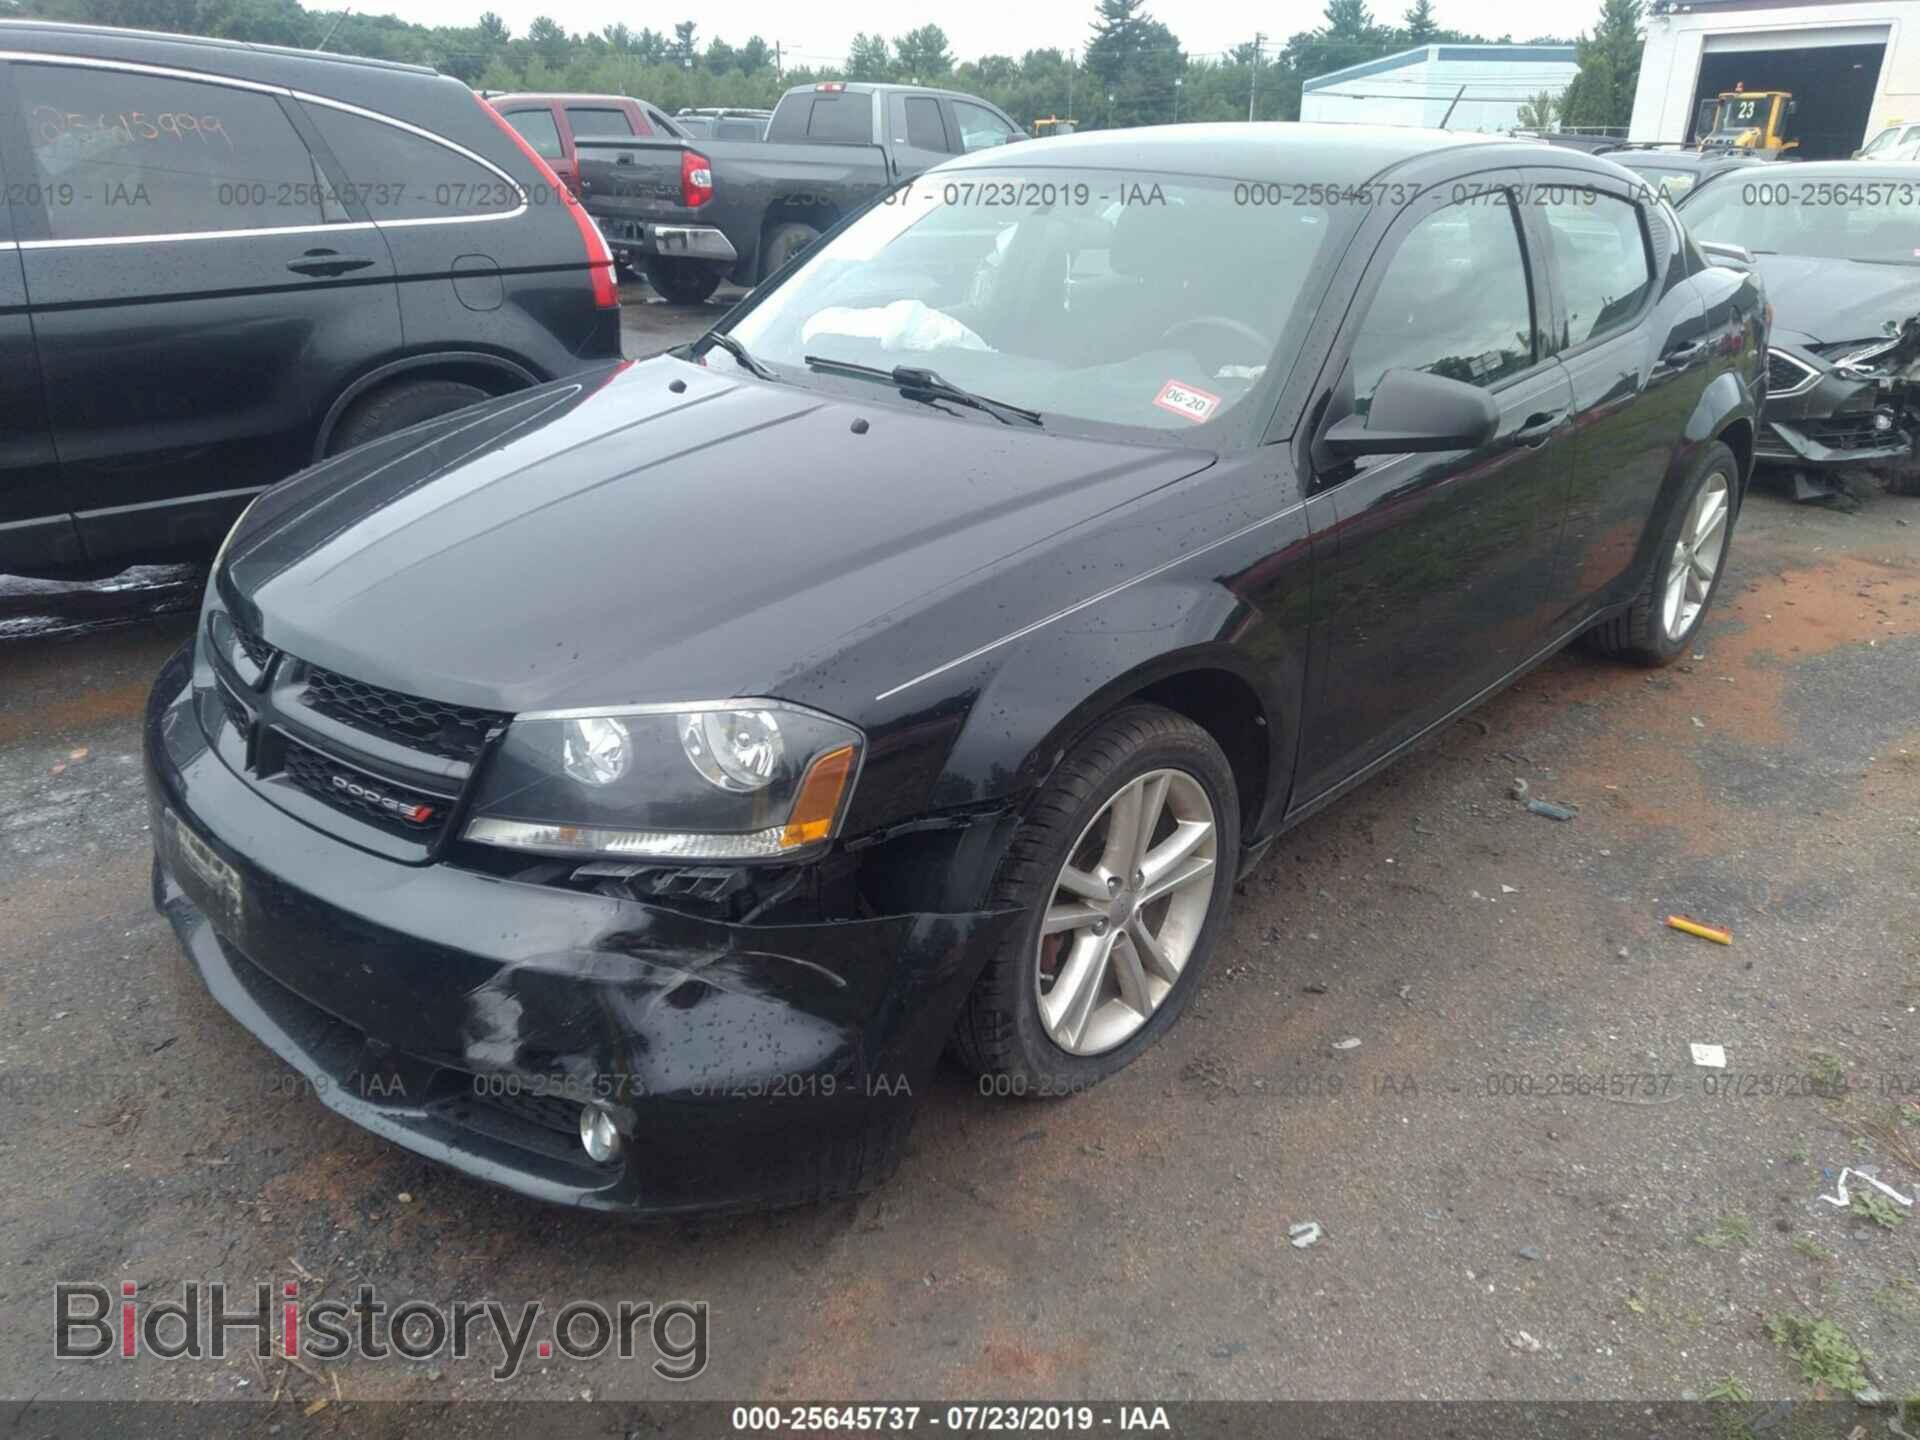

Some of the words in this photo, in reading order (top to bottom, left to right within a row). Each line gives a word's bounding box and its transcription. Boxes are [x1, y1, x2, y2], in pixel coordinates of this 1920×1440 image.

[1737, 101, 1756, 119] 23
[1166, 389, 1206, 411] 06-20
[332, 775, 418, 820] DODGE
